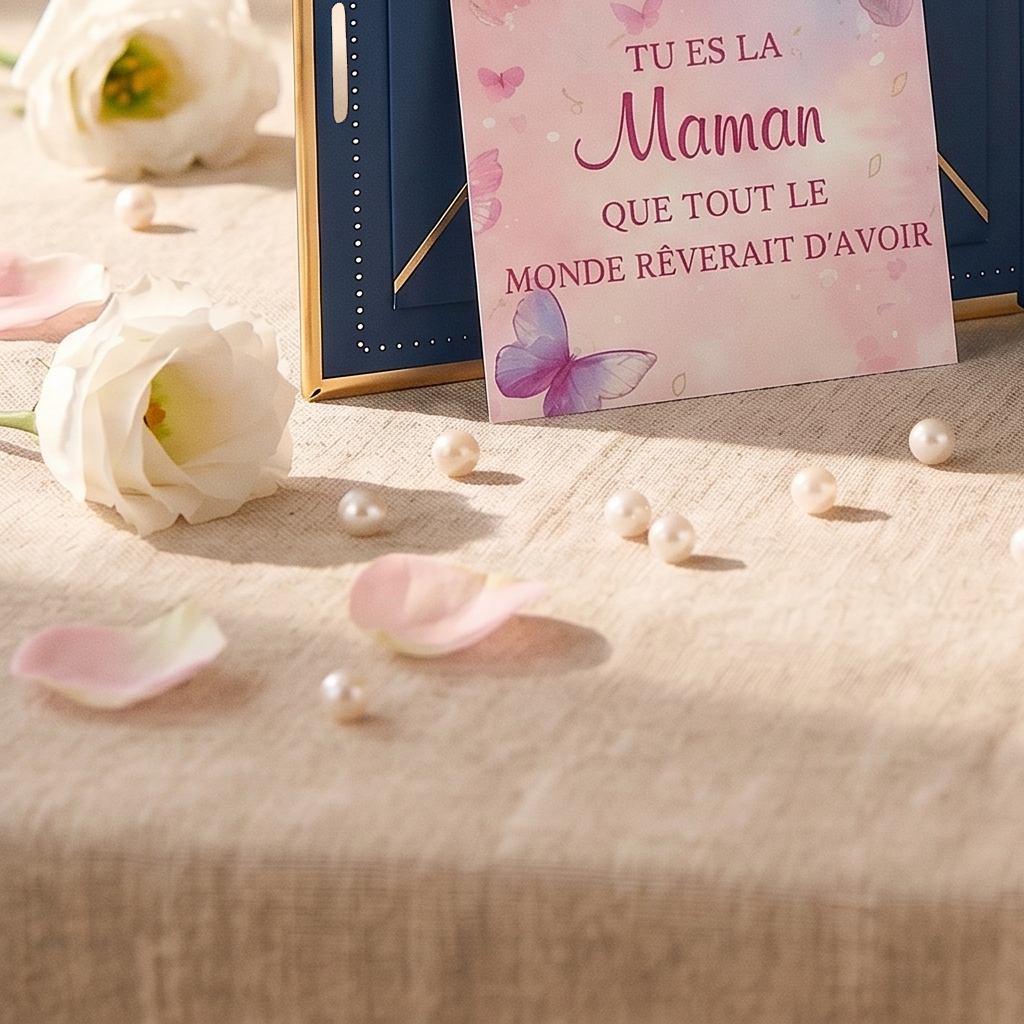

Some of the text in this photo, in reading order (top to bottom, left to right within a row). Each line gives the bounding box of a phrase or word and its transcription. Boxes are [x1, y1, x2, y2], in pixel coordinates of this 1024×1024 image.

[625, 32, 783, 73] TU ES LA
[574, 86, 826, 170] Maman
[602, 179, 829, 233] QUE TOUT LE
[505, 221, 933, 295] MONDE RÊVERAIT D'AVOIR
